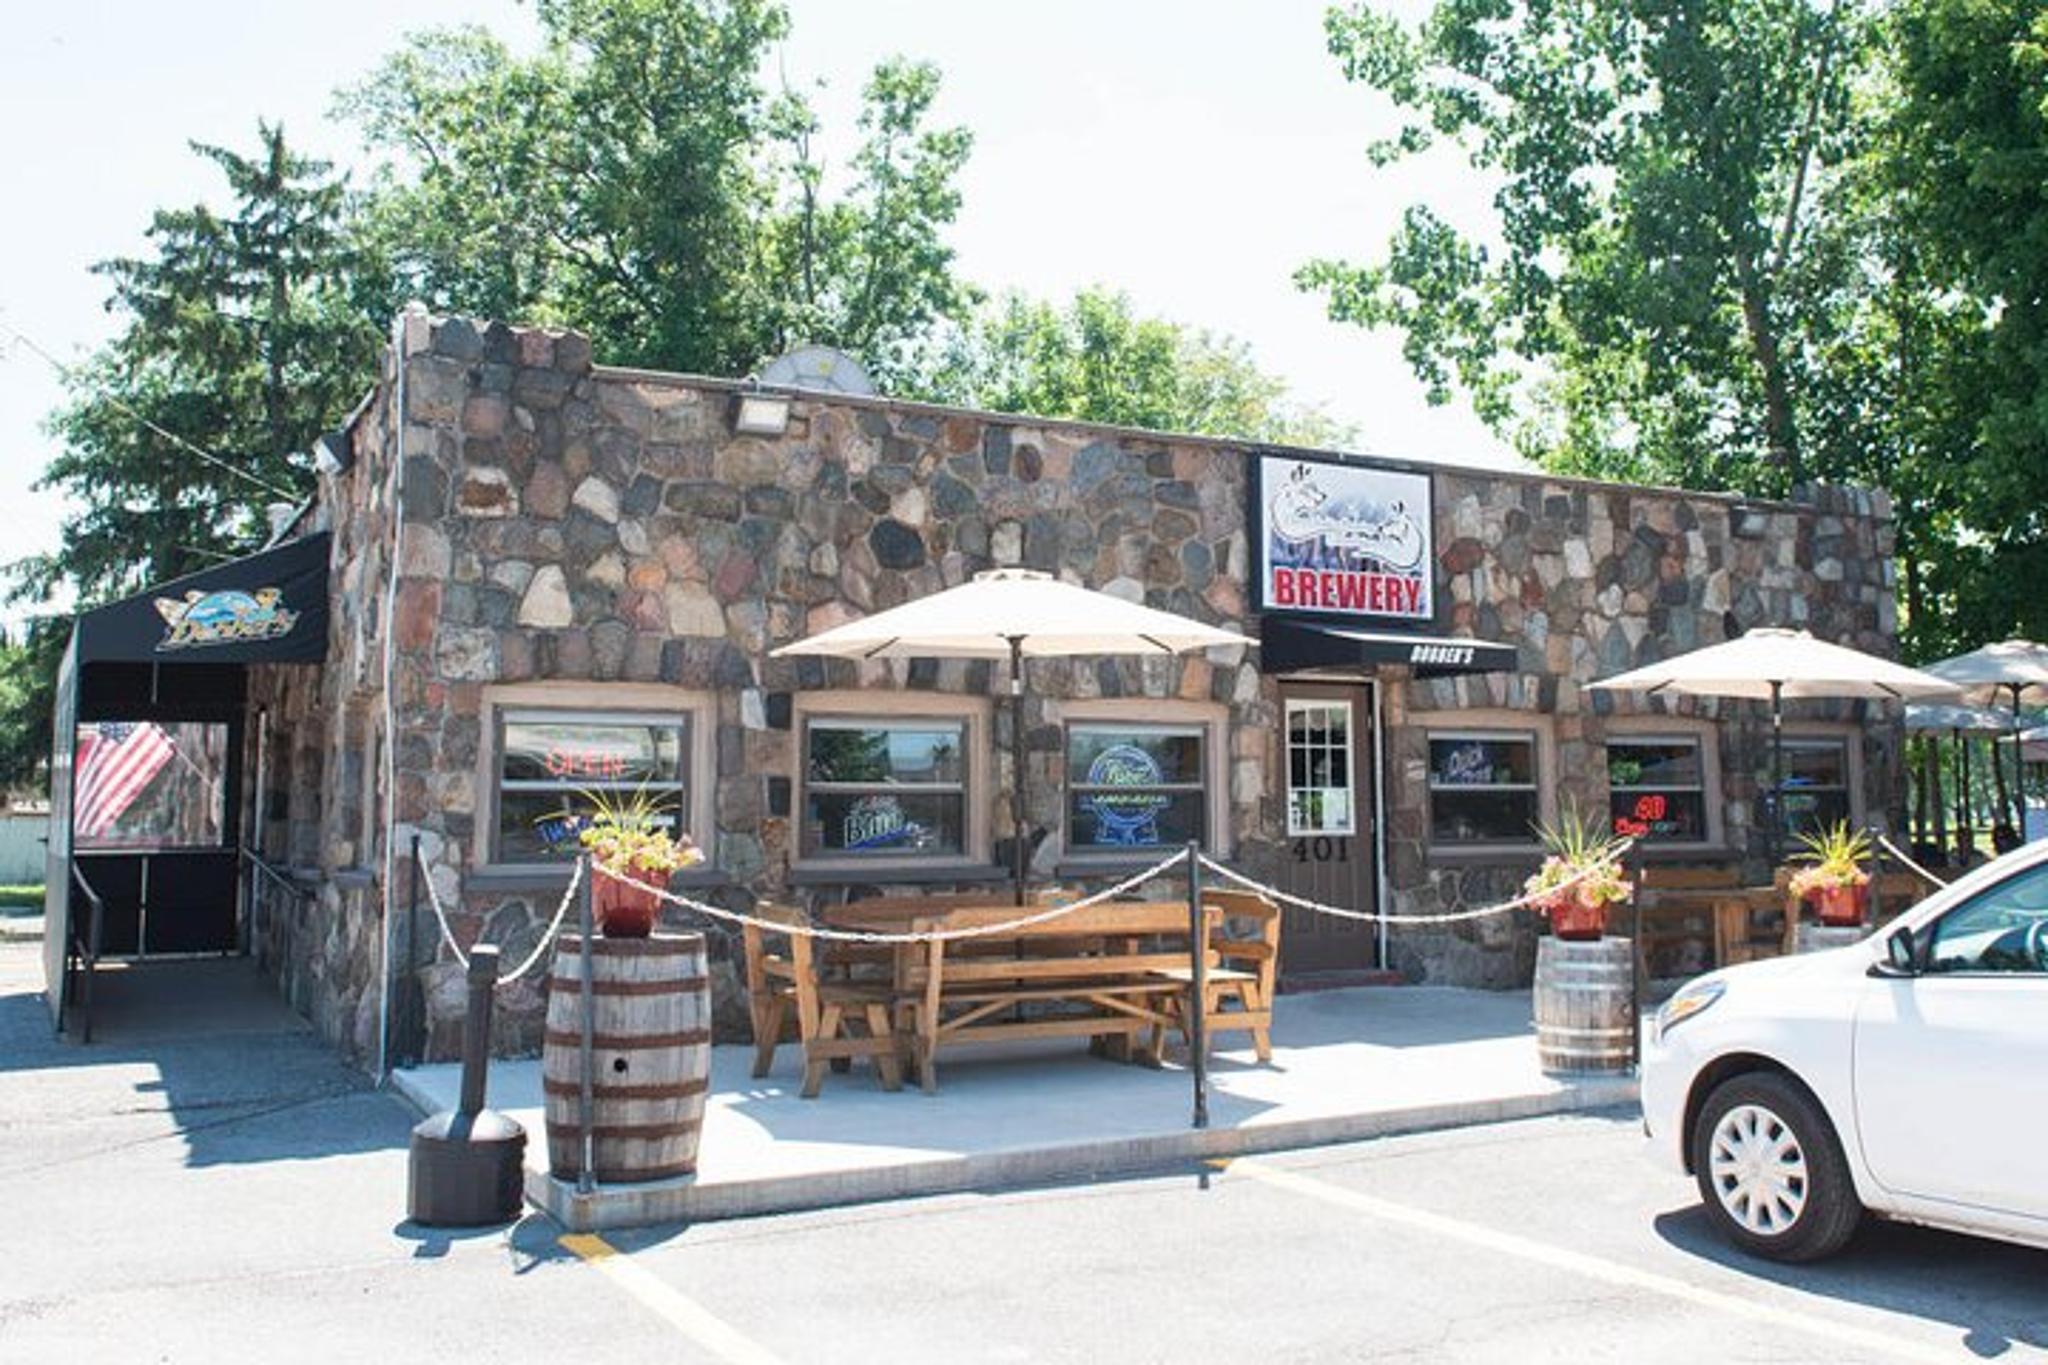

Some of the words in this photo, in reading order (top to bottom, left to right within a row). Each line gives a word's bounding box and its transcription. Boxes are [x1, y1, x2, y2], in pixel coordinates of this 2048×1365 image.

[1275, 569, 1421, 613] BREWERY
[545, 746, 625, 776] OPEN
[1293, 837, 1348, 863] 401
